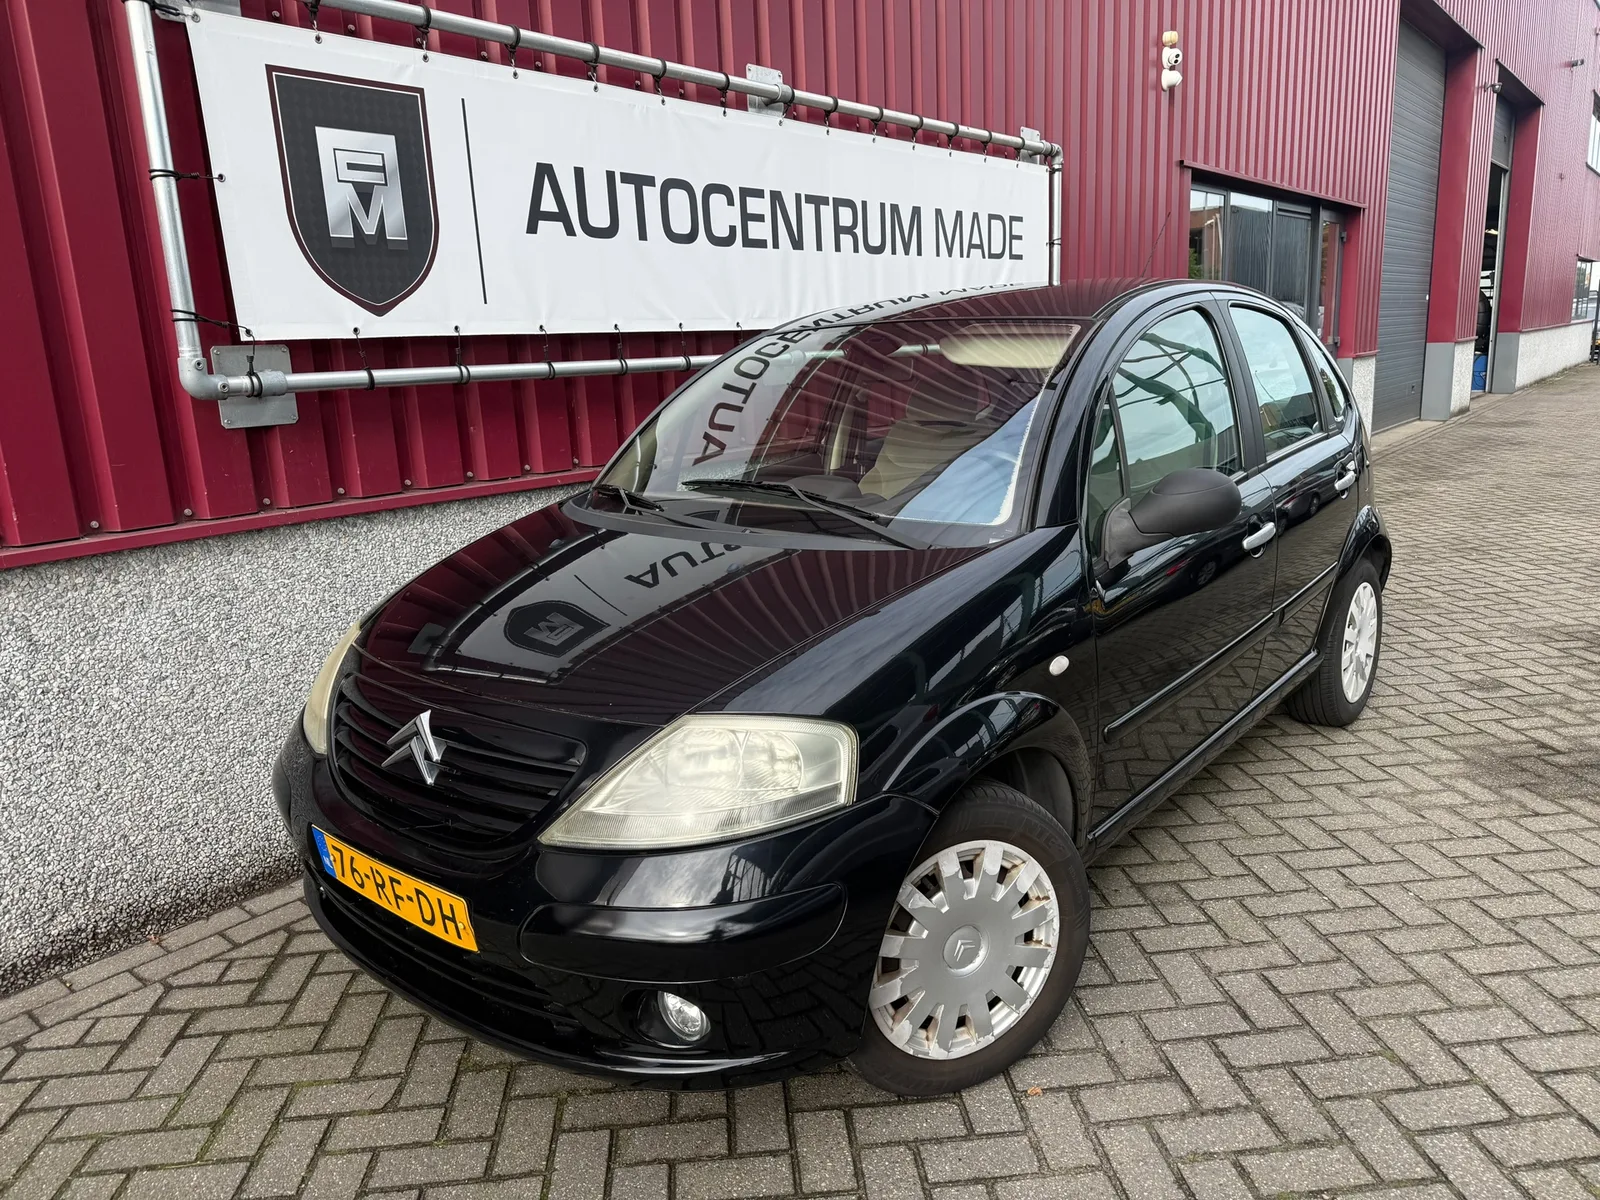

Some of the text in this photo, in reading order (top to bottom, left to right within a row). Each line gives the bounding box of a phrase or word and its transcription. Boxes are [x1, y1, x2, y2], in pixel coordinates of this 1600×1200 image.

[525, 162, 1024, 260] AUTOCENTRUM MADE
[331, 844, 463, 940] 76-RF-DH
